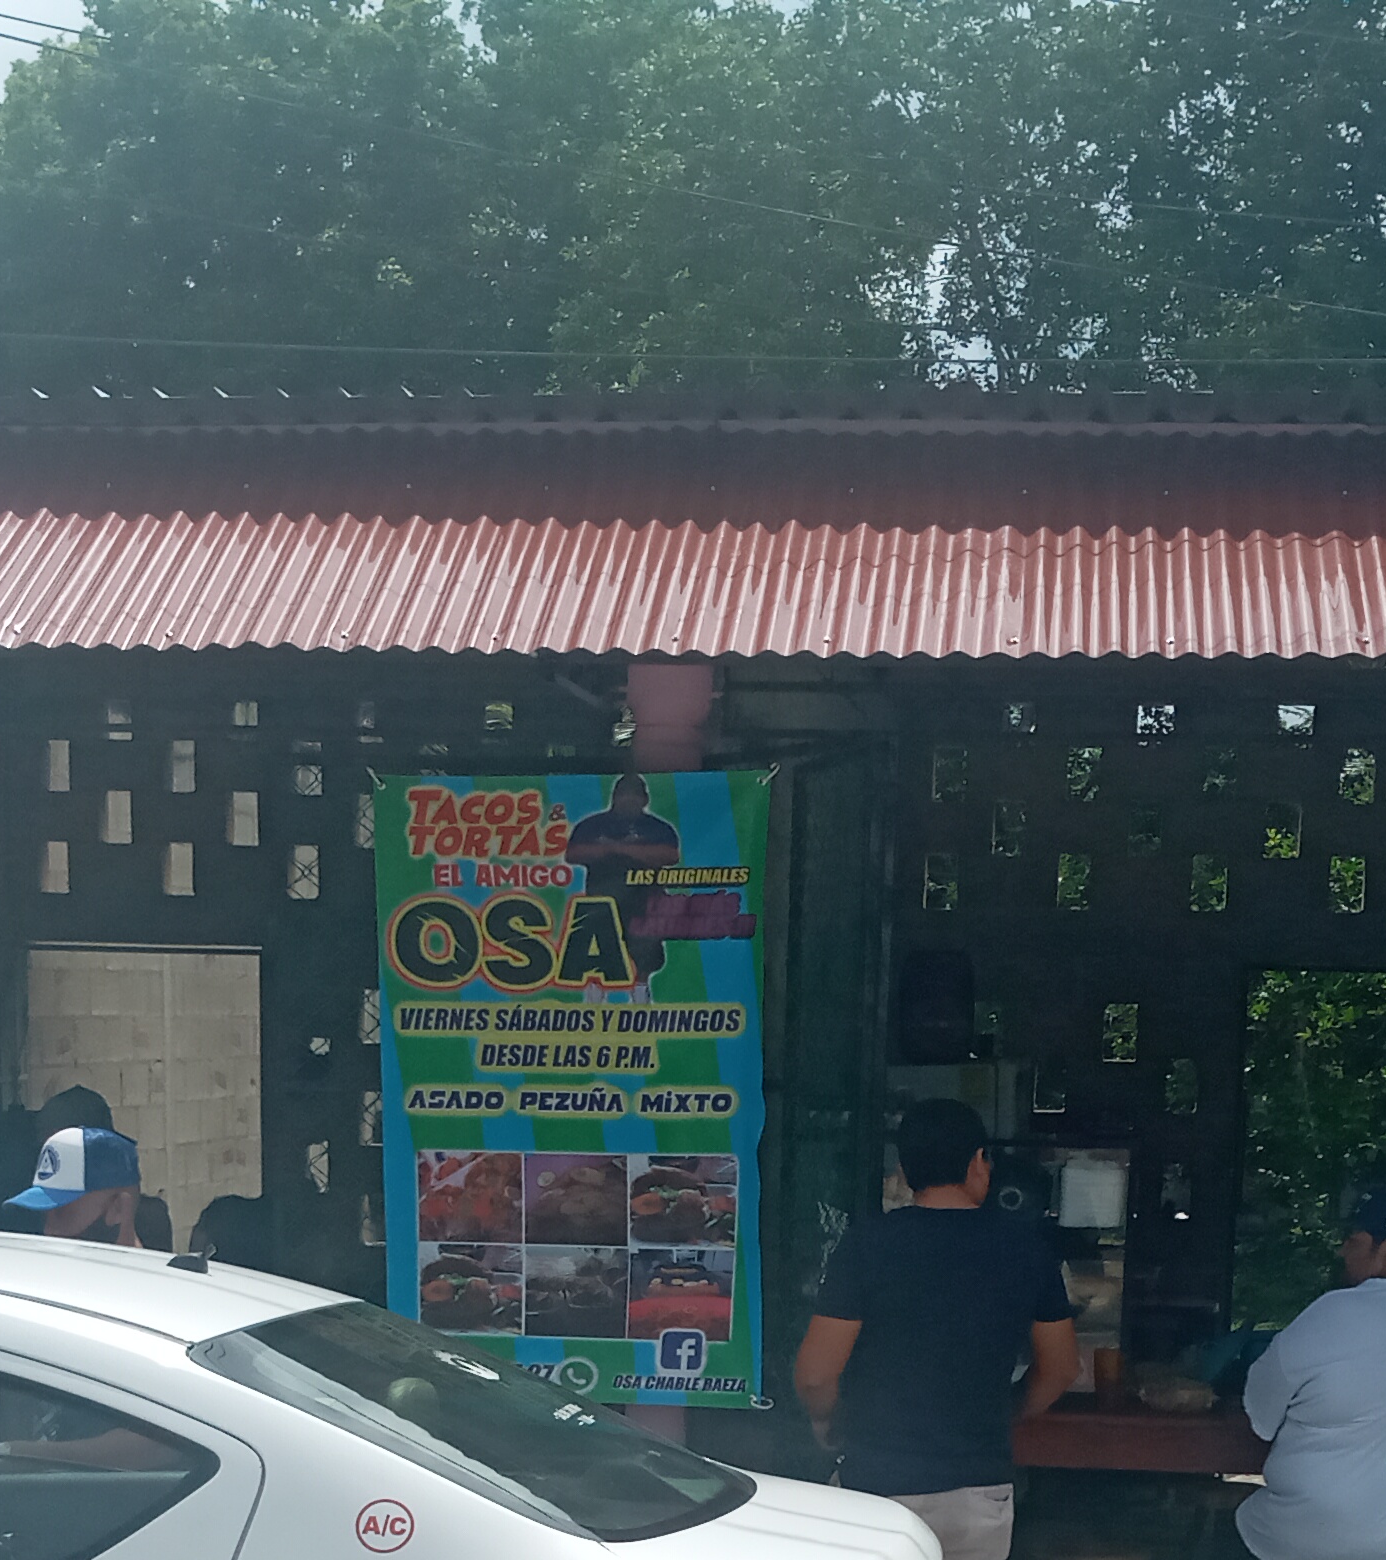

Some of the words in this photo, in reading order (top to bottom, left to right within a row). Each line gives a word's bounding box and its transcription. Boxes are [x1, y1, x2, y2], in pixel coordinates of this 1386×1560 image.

[408, 789, 541, 825] TACOS
[548, 804, 566, 821] &
[408, 824, 568, 857] TORTAS
[433, 864, 462, 887] EL
[475, 864, 573, 887] AMIGO
[625, 869, 655, 885] LAS
[656, 867, 750, 885] ORIGINALES
[389, 895, 635, 989] OSA
[400, 1008, 490, 1032] VIERNES
[494, 1004, 595, 1032] SÁBADOS
[601, 1009, 613, 1031] Y
[617, 1009, 741, 1033] DOMINGOS
[481, 1043, 548, 1068] DESDE
[552, 1045, 591, 1068] LAS
[595, 1046, 611, 1068] 6
[615, 1047, 656, 1069] P.M.
[408, 1089, 505, 1110] ASADO
[519, 1086, 625, 1113] PEZUÑA
[613, 1375, 642, 1390] OSA
[645, 1376, 700, 1391] CHABLE
[362, 1514, 408, 1537] A/C
